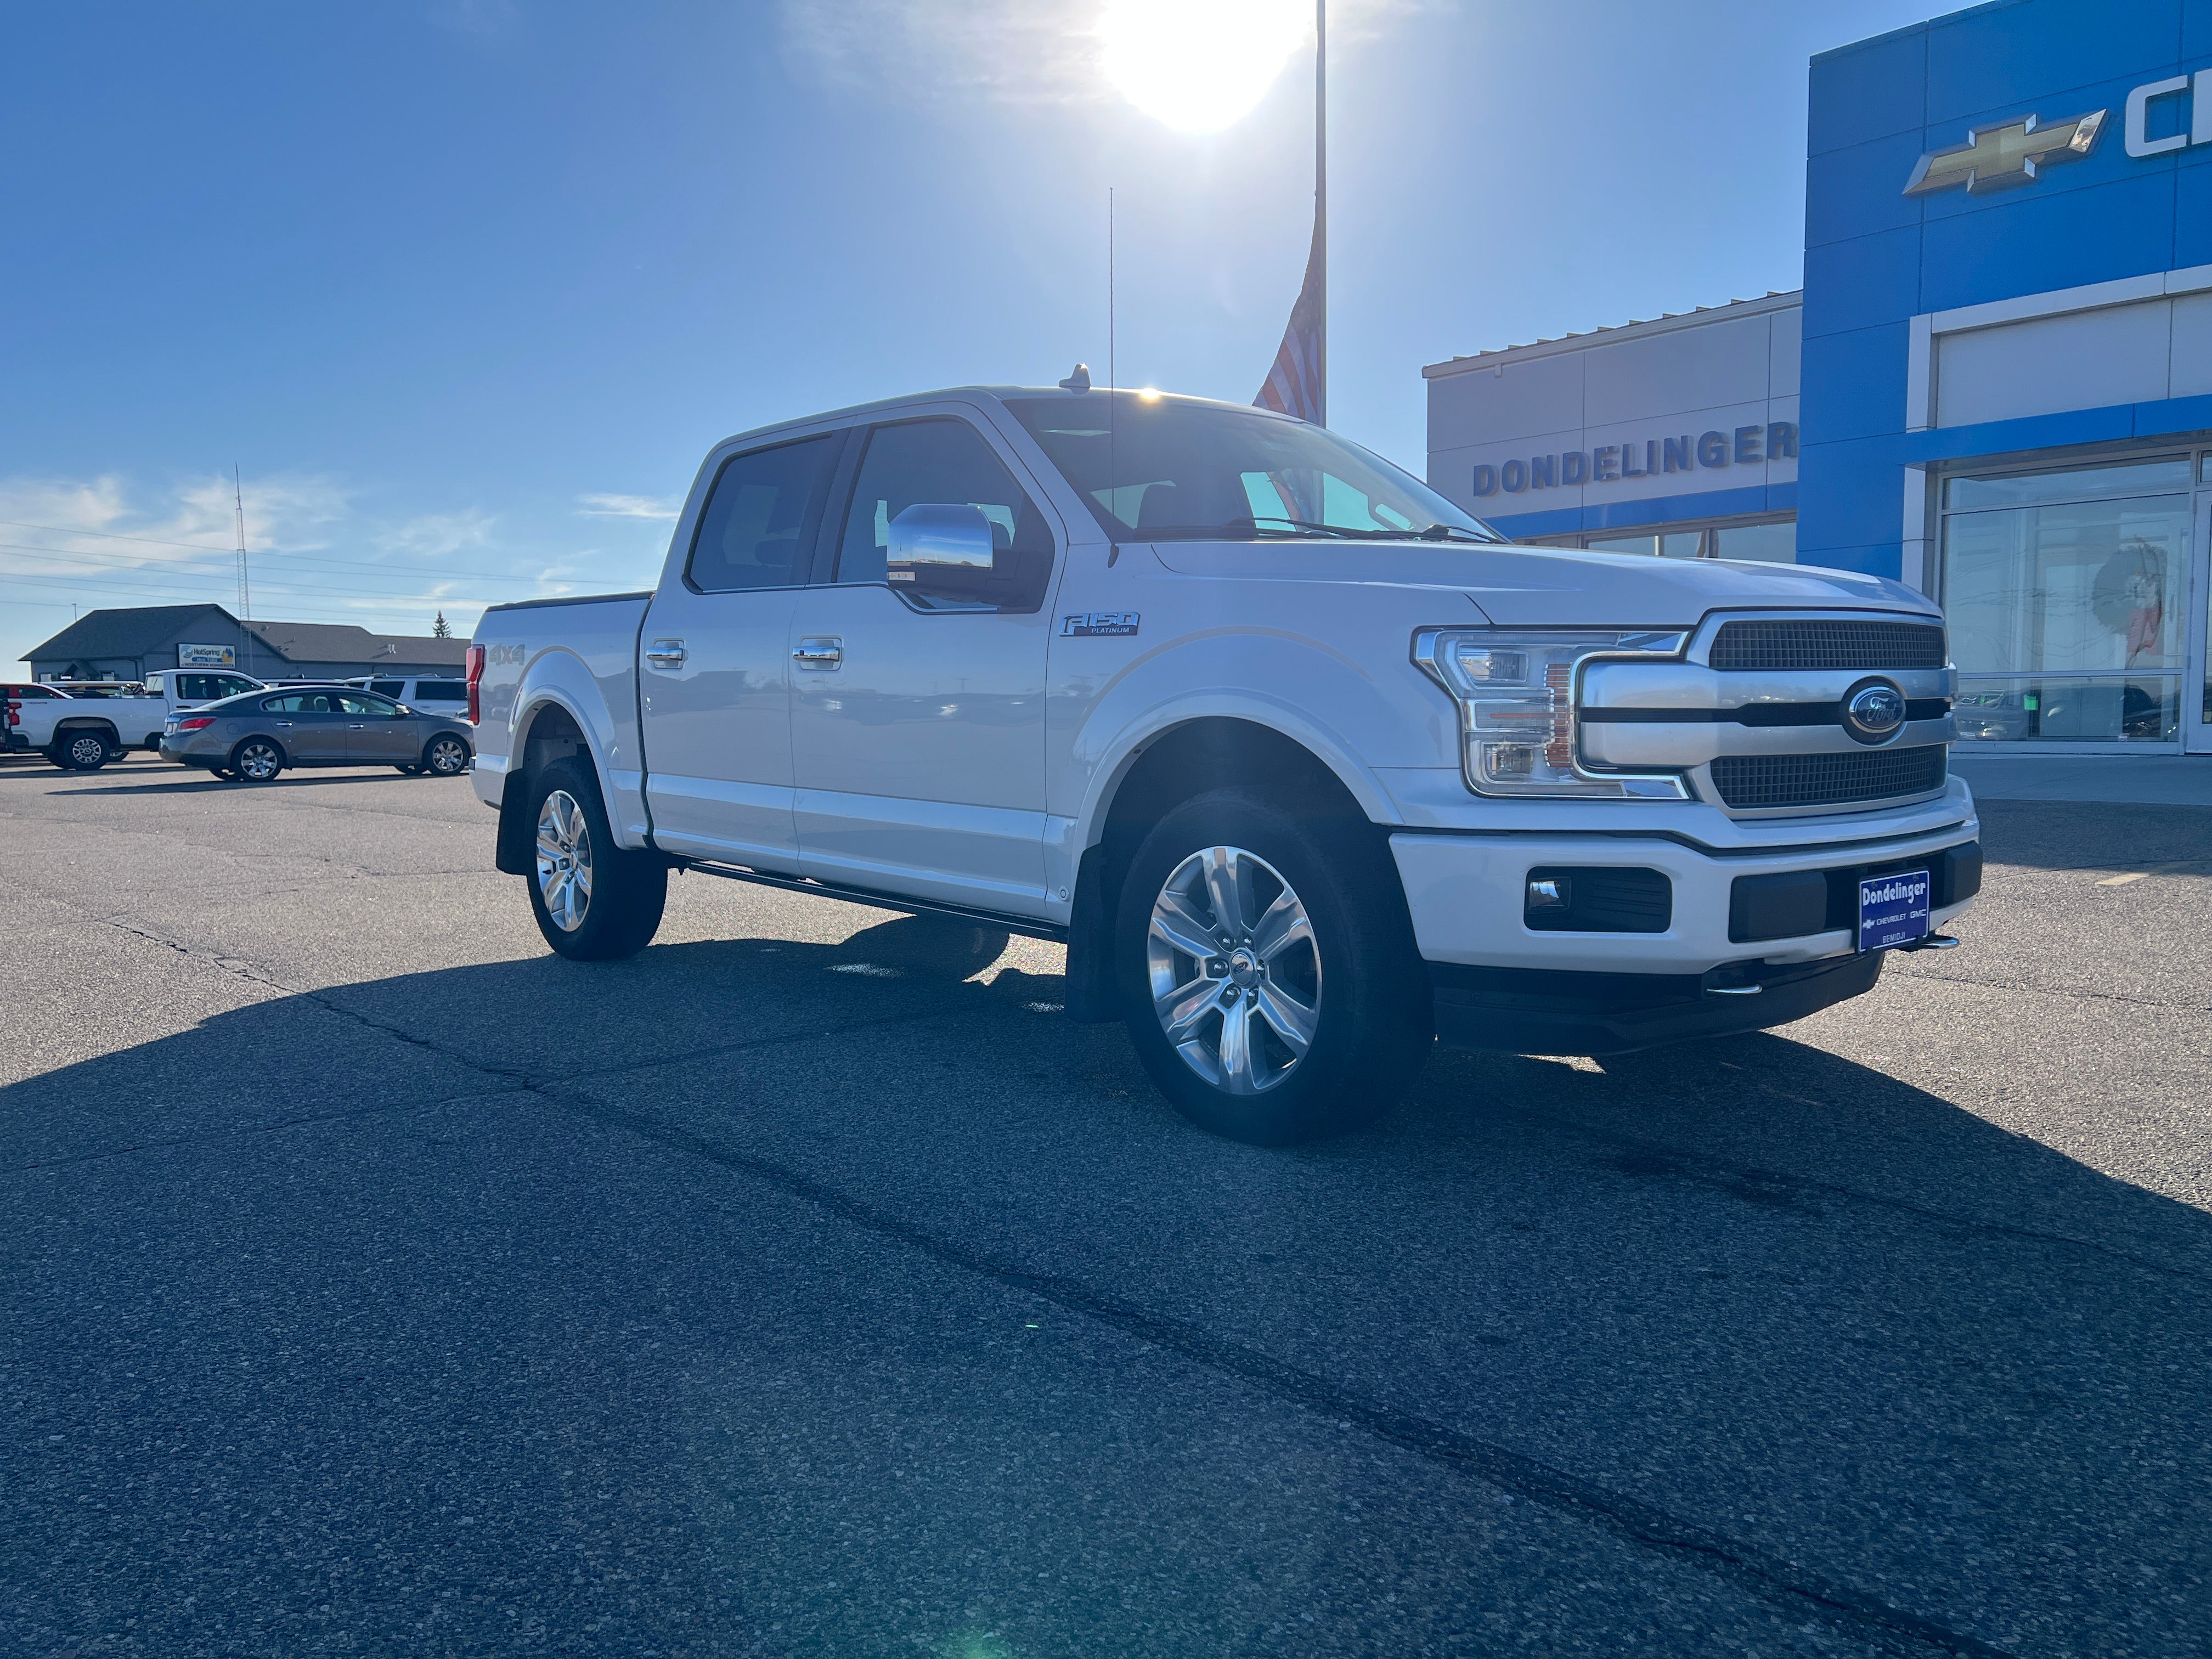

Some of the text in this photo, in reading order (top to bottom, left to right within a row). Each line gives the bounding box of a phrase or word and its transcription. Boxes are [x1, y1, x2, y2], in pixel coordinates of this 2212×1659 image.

[1473, 421, 1797, 497] DONDELINGER
[194, 648, 220, 656] HotSpring
[1866, 696, 1897, 721] Ford
[1862, 882, 1926, 906] Dondelinger
[1876, 909, 1927, 926] CHEVROLET GMC
[1882, 932, 1906, 944] BEMIDJI
